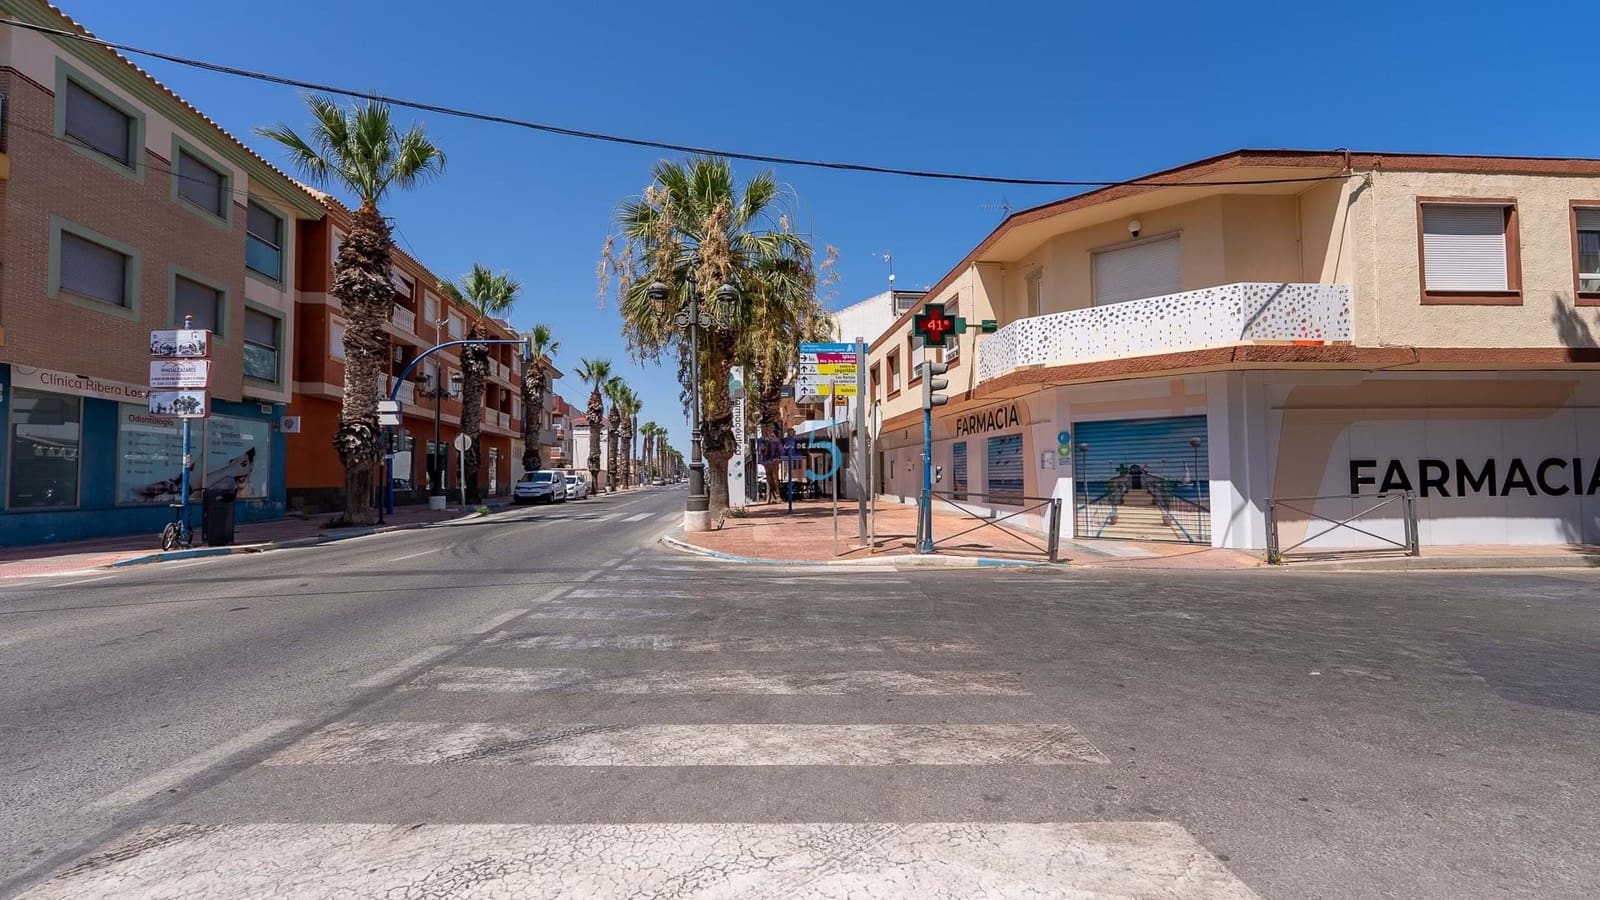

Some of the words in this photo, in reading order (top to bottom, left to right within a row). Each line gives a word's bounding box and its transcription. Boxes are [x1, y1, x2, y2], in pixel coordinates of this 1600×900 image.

[40, 372, 82, 390] Clínica
[86, 378, 122, 396] Ribera
[125, 385, 143, 397] Los
[956, 404, 1019, 438] FARMACIA
